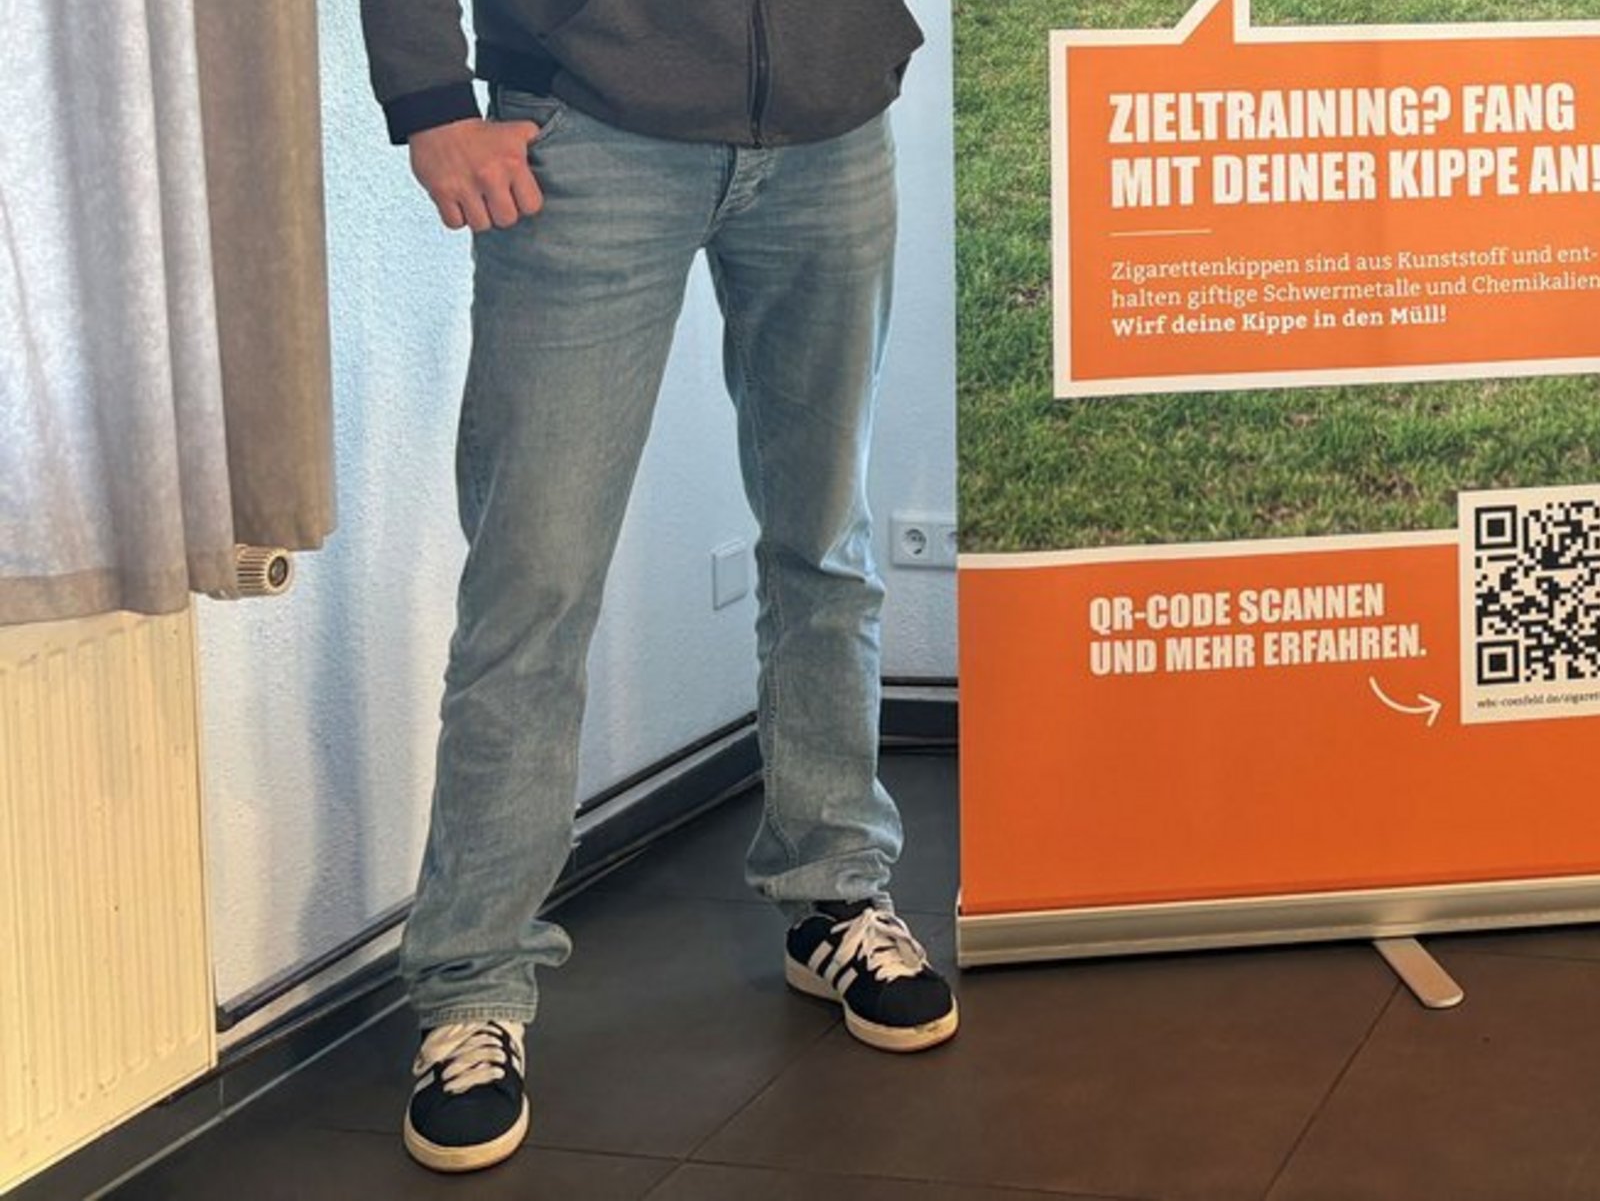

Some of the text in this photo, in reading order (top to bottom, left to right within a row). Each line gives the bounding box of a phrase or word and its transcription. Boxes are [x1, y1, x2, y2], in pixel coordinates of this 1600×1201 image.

[1108, 83, 1575, 143] ZIELTRAINING? FANG
[1110, 156, 1201, 207] MIT
[1212, 151, 1376, 204] DEINER
[1388, 146, 1518, 198] KIPPE
[1111, 245, 1598, 284] Zigarettenkippen sind aus Kunststoff und ent-
[1112, 288, 1181, 308] halten
[1187, 286, 1258, 310] giftige
[1263, 279, 1421, 302] Schwermetalle
[1425, 277, 1467, 296] und
[1111, 304, 1447, 336] Wirf deine Kippe in den Müll!
[1089, 582, 1385, 635] QR-CODE SCANNEN
[1090, 624, 1427, 676] UND MEHR ERFAHREN.
